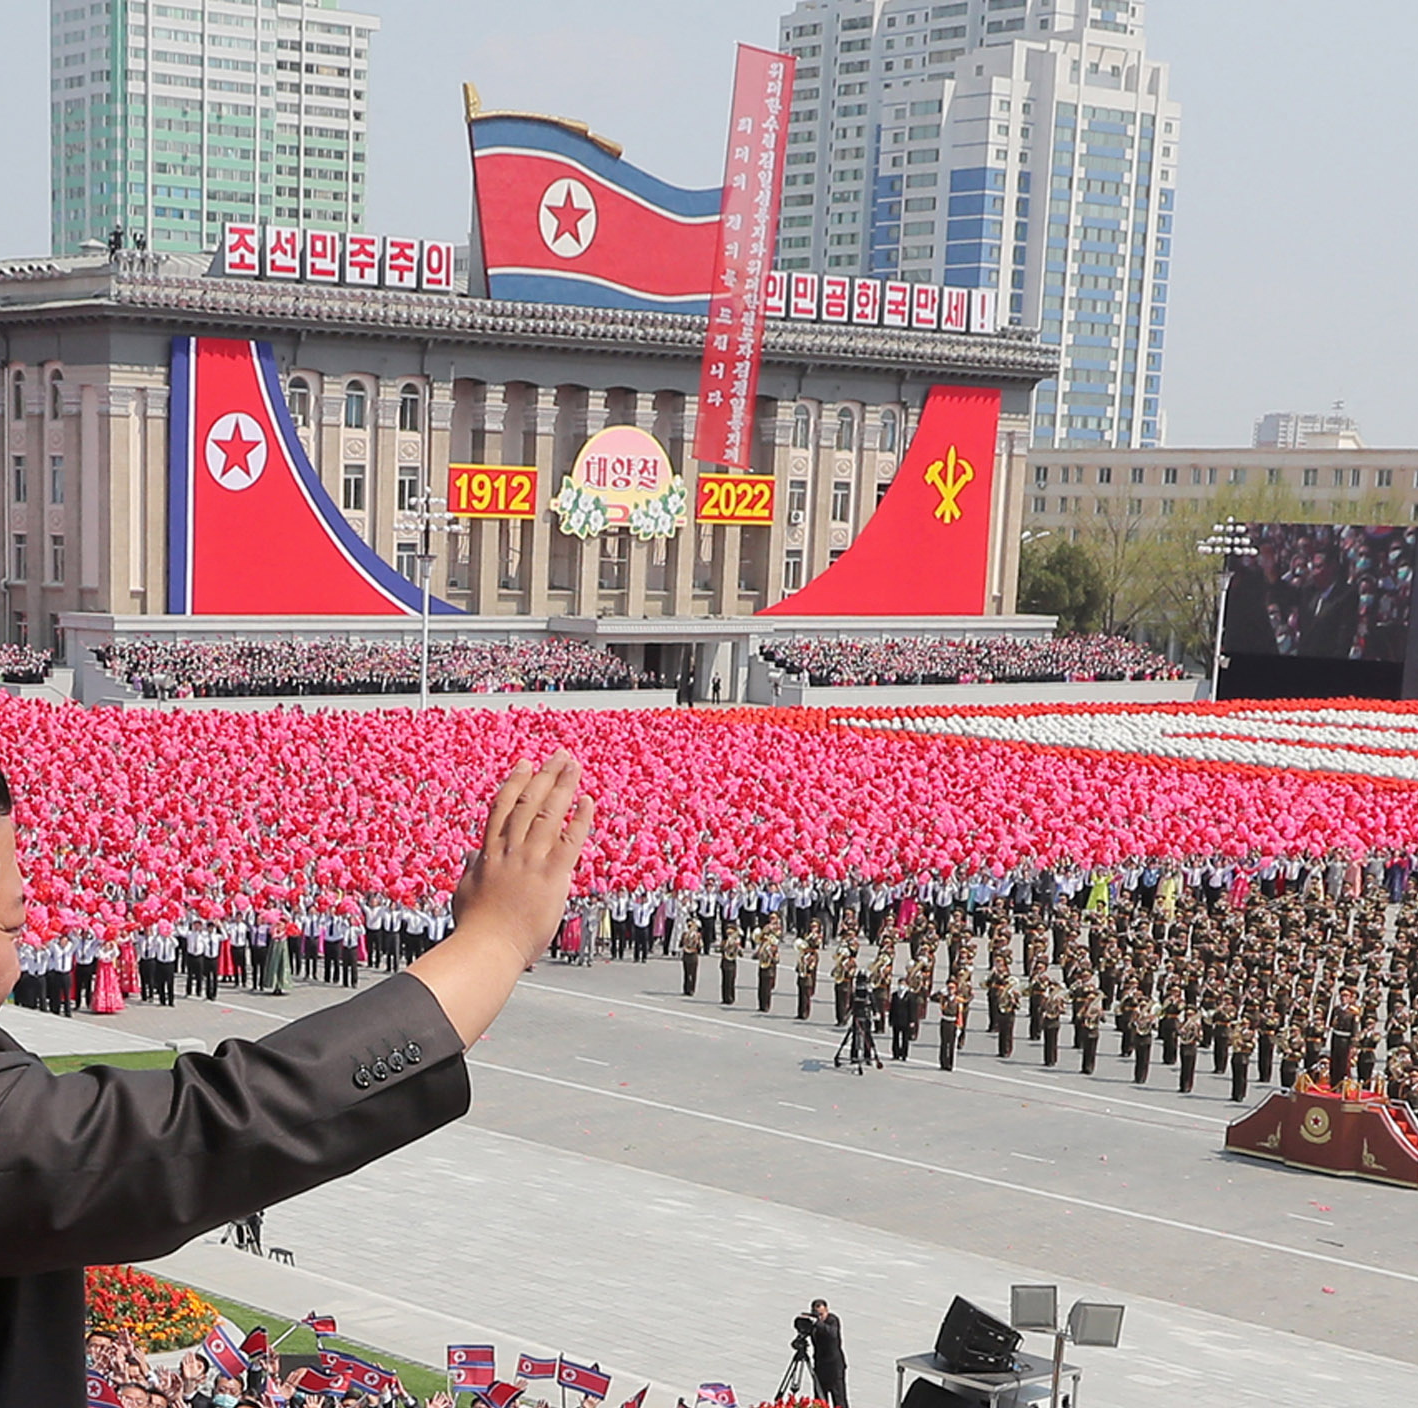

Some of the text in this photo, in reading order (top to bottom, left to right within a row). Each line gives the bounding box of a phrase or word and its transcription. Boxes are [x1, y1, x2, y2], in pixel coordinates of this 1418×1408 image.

[228, 226, 452, 287] 조선민주주의
[454, 472, 532, 512] 1912
[584, 455, 660, 492] 태양절
[700, 481, 771, 517] 2022
